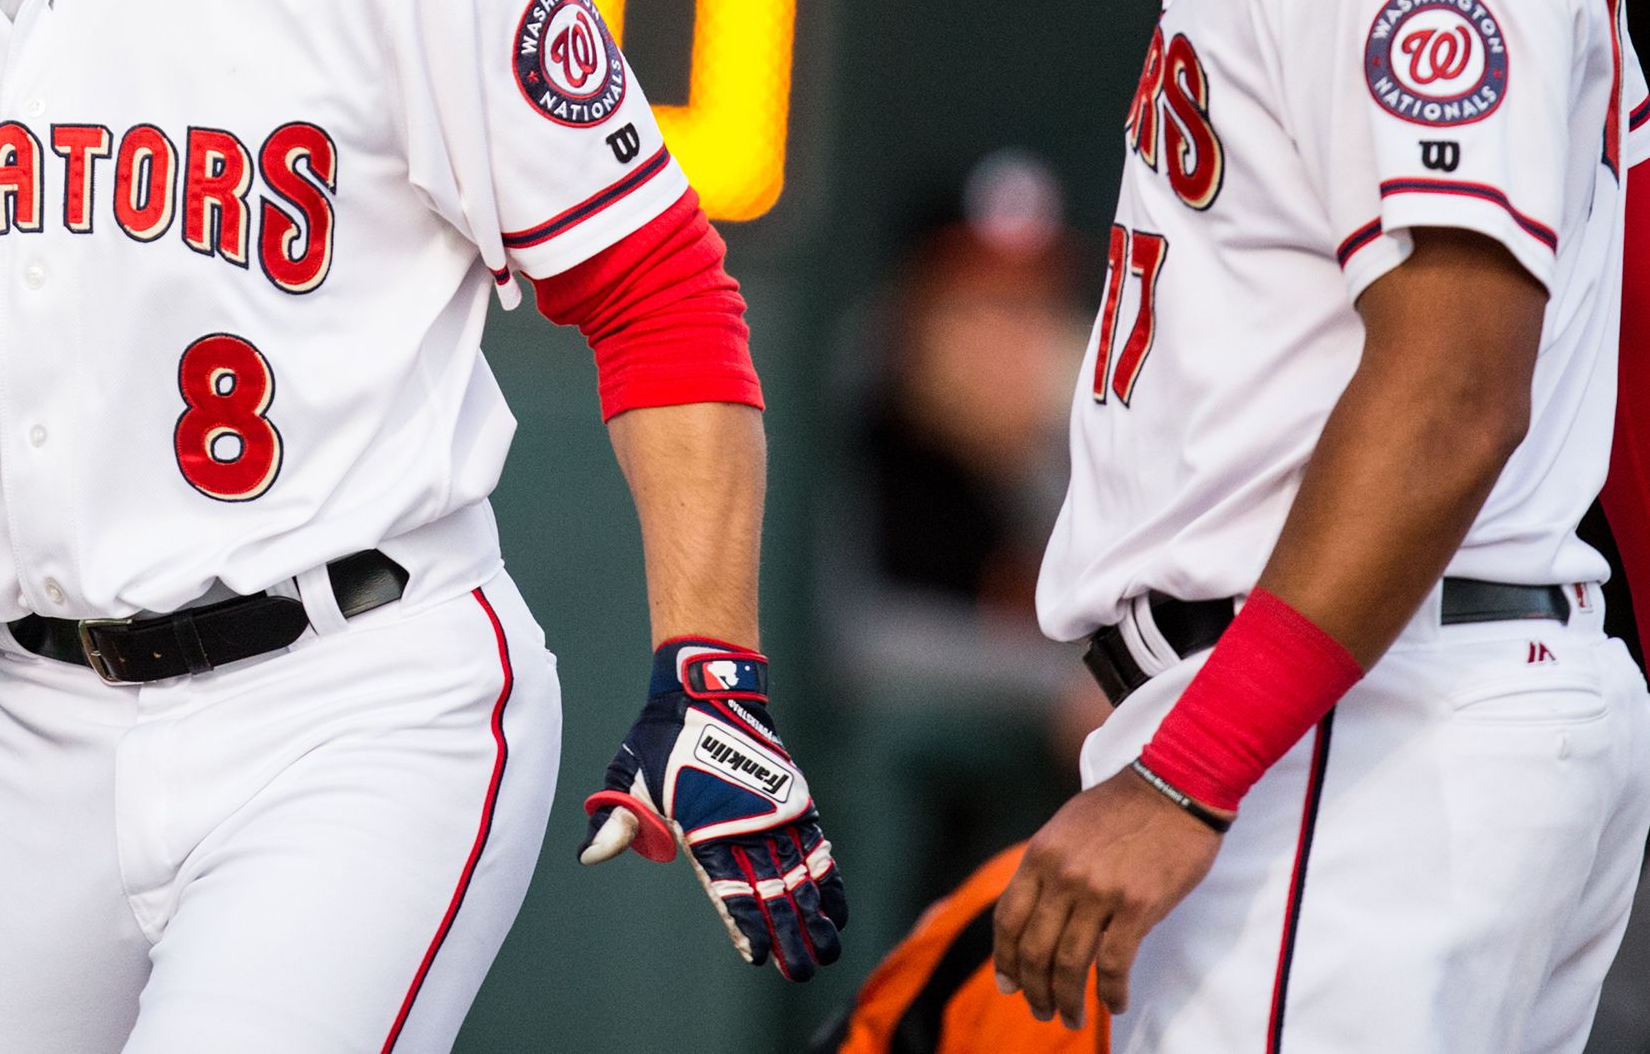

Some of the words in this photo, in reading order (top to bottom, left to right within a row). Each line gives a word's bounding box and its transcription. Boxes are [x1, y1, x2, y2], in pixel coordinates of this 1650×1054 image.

[539, 57, 623, 122] NATIONALS
[1374, 75, 1498, 121] NATIONALS
[1093, 222, 1169, 409] 17
[173, 332, 284, 503] 8
